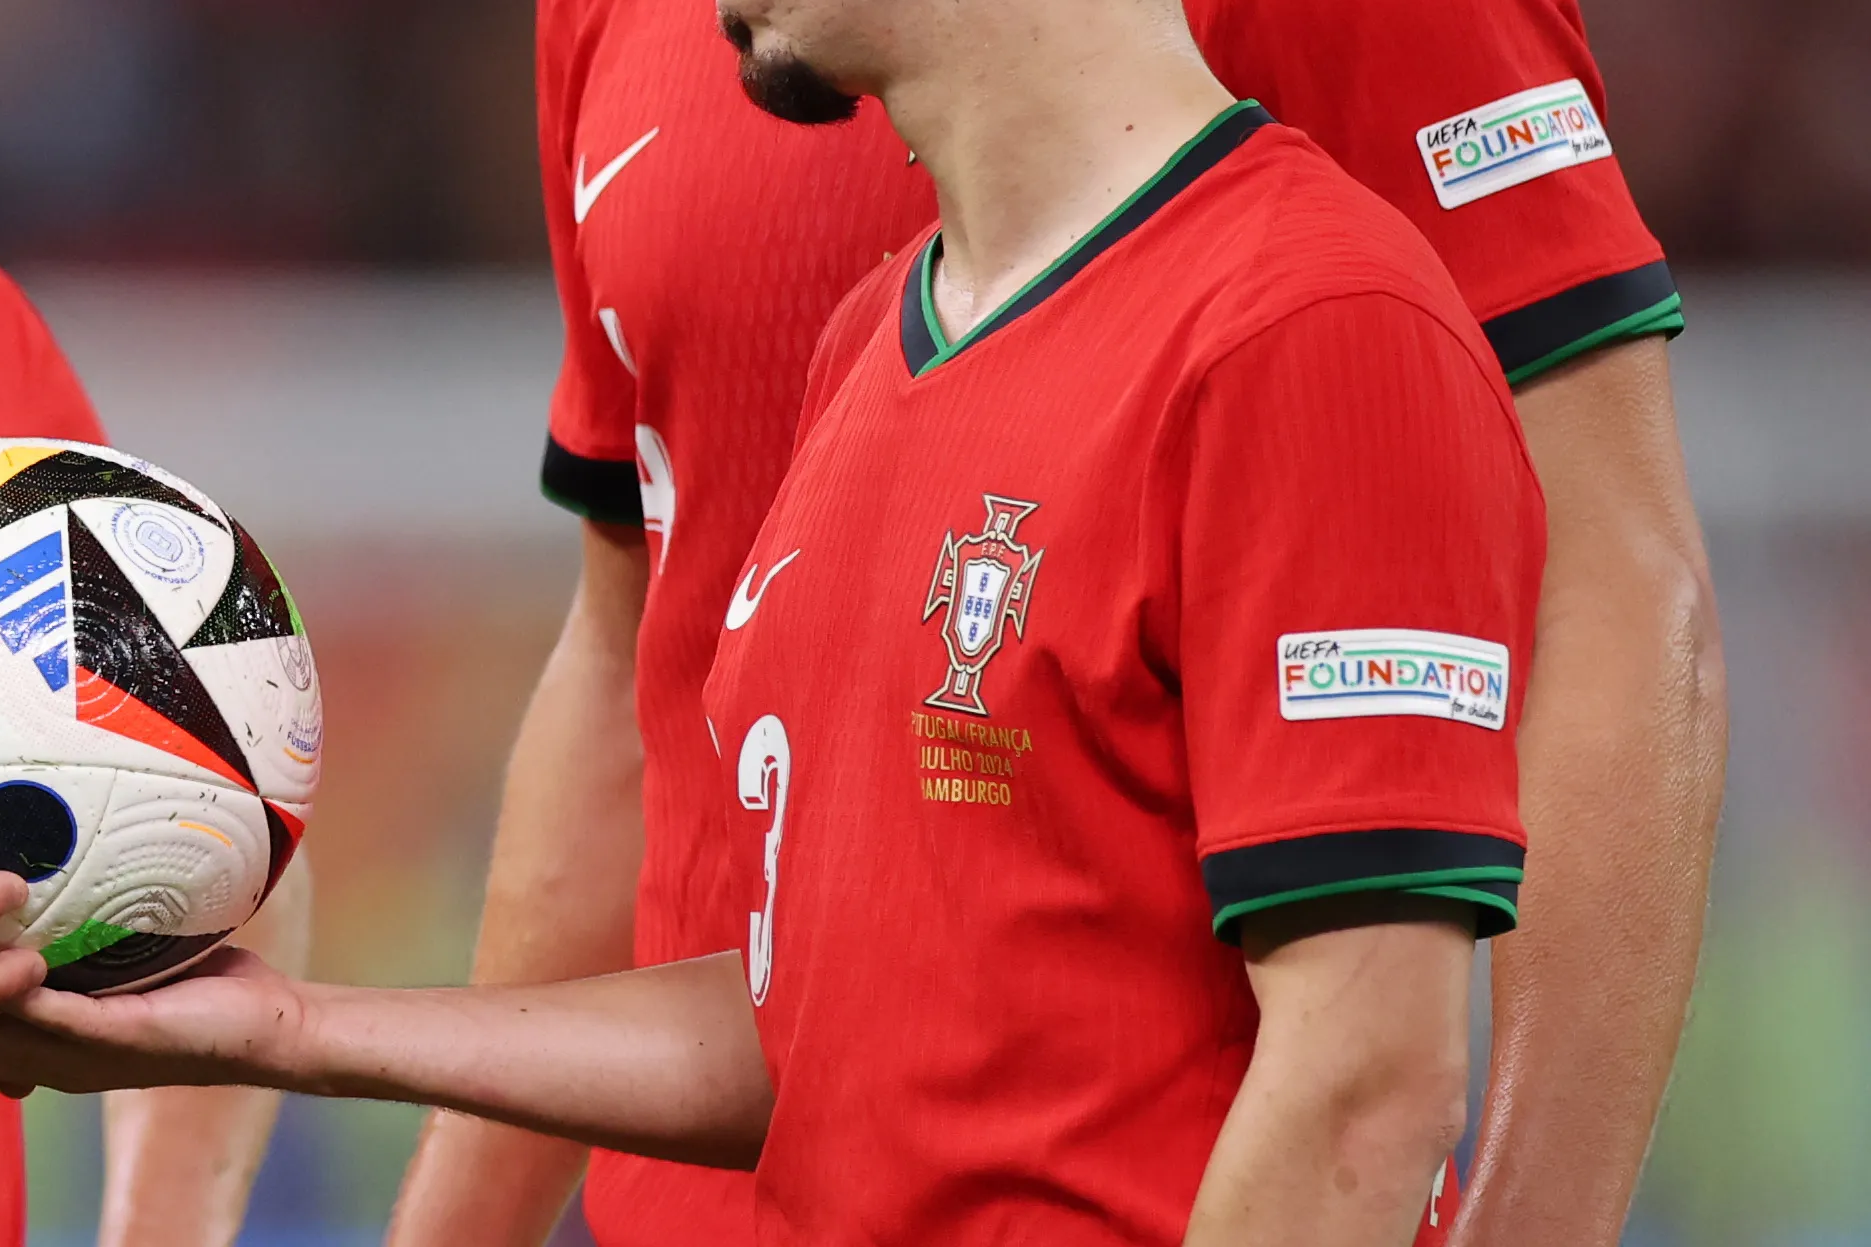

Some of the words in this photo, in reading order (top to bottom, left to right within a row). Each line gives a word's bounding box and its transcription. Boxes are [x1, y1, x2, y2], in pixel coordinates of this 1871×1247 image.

[1427, 117, 1478, 149] UEFA
[1432, 103, 1597, 178] FOUNDATION
[1284, 639, 1342, 661] UEFA
[1285, 659, 1503, 702] FOUNDATION
[920, 746, 973, 772] JULHO
[976, 752, 1014, 778] 2024
[706, 714, 791, 1008] 3
